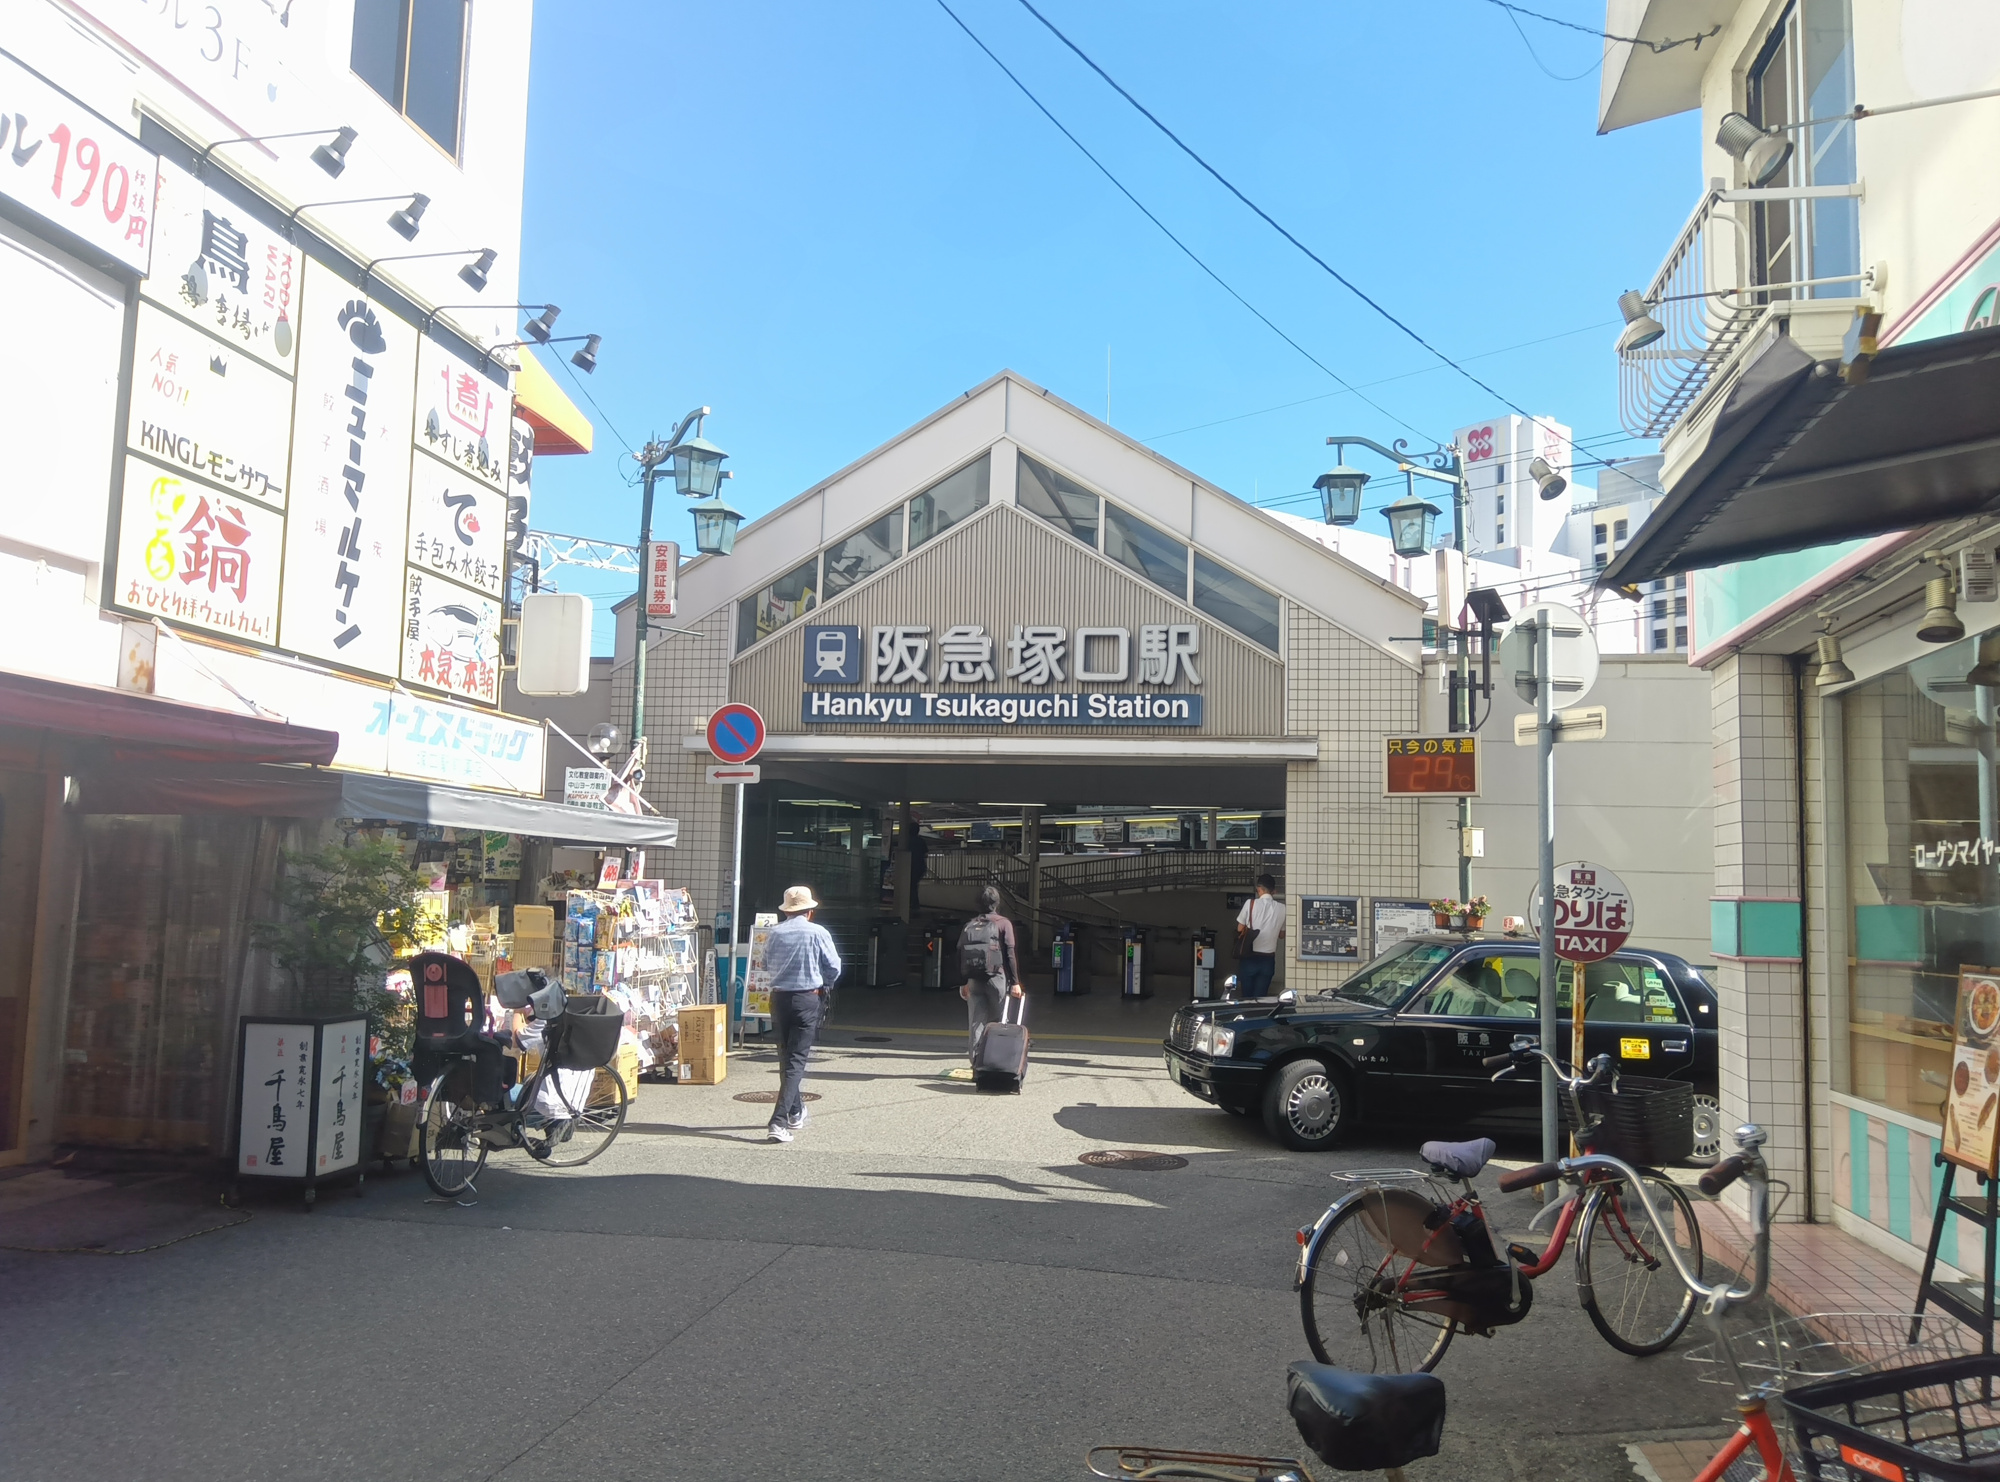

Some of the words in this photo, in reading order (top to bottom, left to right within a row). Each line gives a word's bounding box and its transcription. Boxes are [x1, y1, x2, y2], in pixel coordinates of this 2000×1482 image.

[201, 208, 250, 295] 鳥
[150, 346, 179, 375] 人気
[424, 418, 502, 484] 牛すじ煮込み
[332, 356, 374, 650] ニューマルケン
[414, 532, 501, 591] 手包み水餃子
[653, 544, 669, 603] 安藤証券
[406, 573, 423, 642] 餃子屋
[649, 604, 671, 612] ANDO
[869, 623, 1203, 687] 阪急塚口駅
[811, 692, 912, 723] Hankyu
[920, 692, 1079, 724] Tsukaguchi
[1087, 693, 1190, 719] Station
[364, 699, 535, 763] オーエスドラッグ
[1388, 738, 1475, 755] 只今の気温
[568, 781, 607, 791] 中山ヨーガ教室
[1553, 884, 1624, 900] 急タクシー
[1554, 899, 1627, 931] のりば
[1555, 934, 1607, 953] TAXI
[1457, 1032, 1491, 1046] 阪急
[1462, 1049, 1487, 1057] TAXI
[1357, 1055, 1389, 1063] (いたみ)
[265, 1069, 287, 1166] 千鳥屋
[332, 1065, 347, 1161] 千鳥屋
